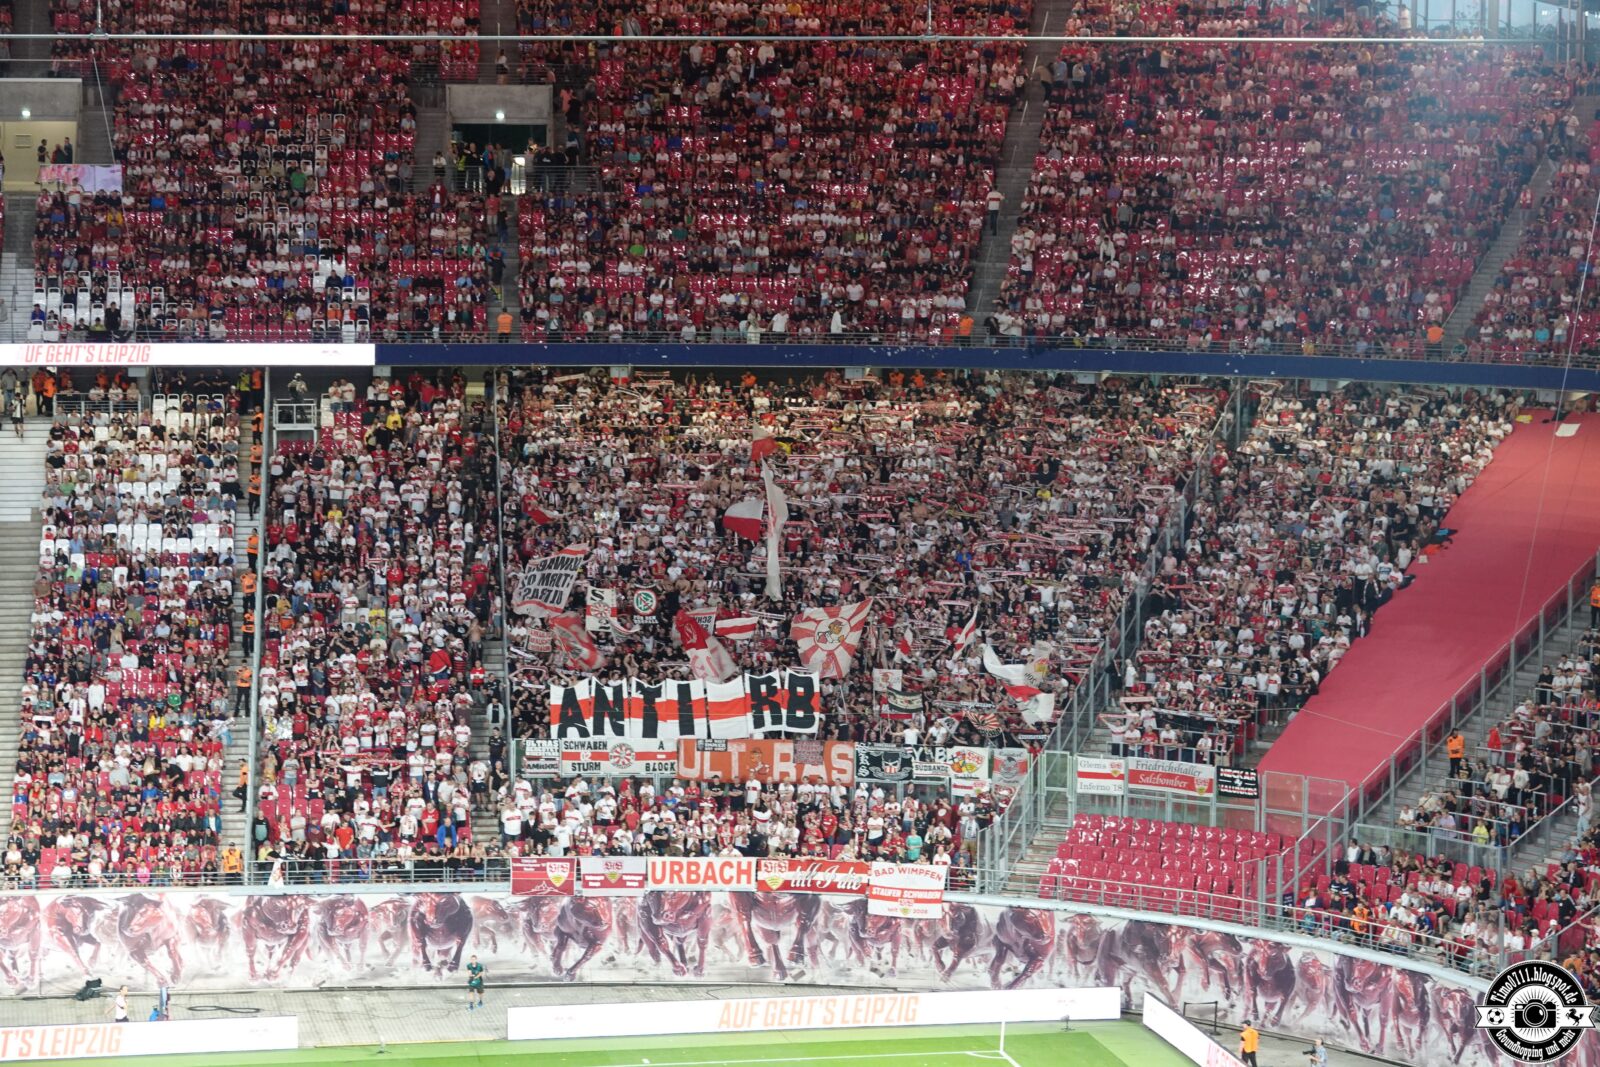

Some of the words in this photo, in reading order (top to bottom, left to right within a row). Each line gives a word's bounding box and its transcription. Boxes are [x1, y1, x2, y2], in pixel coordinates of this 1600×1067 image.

[45, 345, 96, 363] GEHT'S
[98, 345, 151, 363] LEIPZIG
[557, 680, 695, 738] ANTI
[749, 675, 816, 730] RB
[563, 740, 608, 750] SCHWABEN
[658, 741, 665, 750] A
[571, 762, 601, 772] STURM
[645, 762, 676, 772] BLOCK
[1135, 760, 1202, 777] Friedrichshaller
[1079, 782, 1111, 791] Inferno
[1138, 773, 1189, 788] Salzbomber
[651, 860, 753, 885] URBACH
[874, 867, 895, 877] BAD
[898, 867, 943, 882] WIMPFEN
[718, 1000, 760, 1029] AUF
[763, 998, 837, 1027] GEHT'S
[840, 995, 920, 1025] LEIPZIG
[40, 1025, 123, 1056] LEIPZIG
